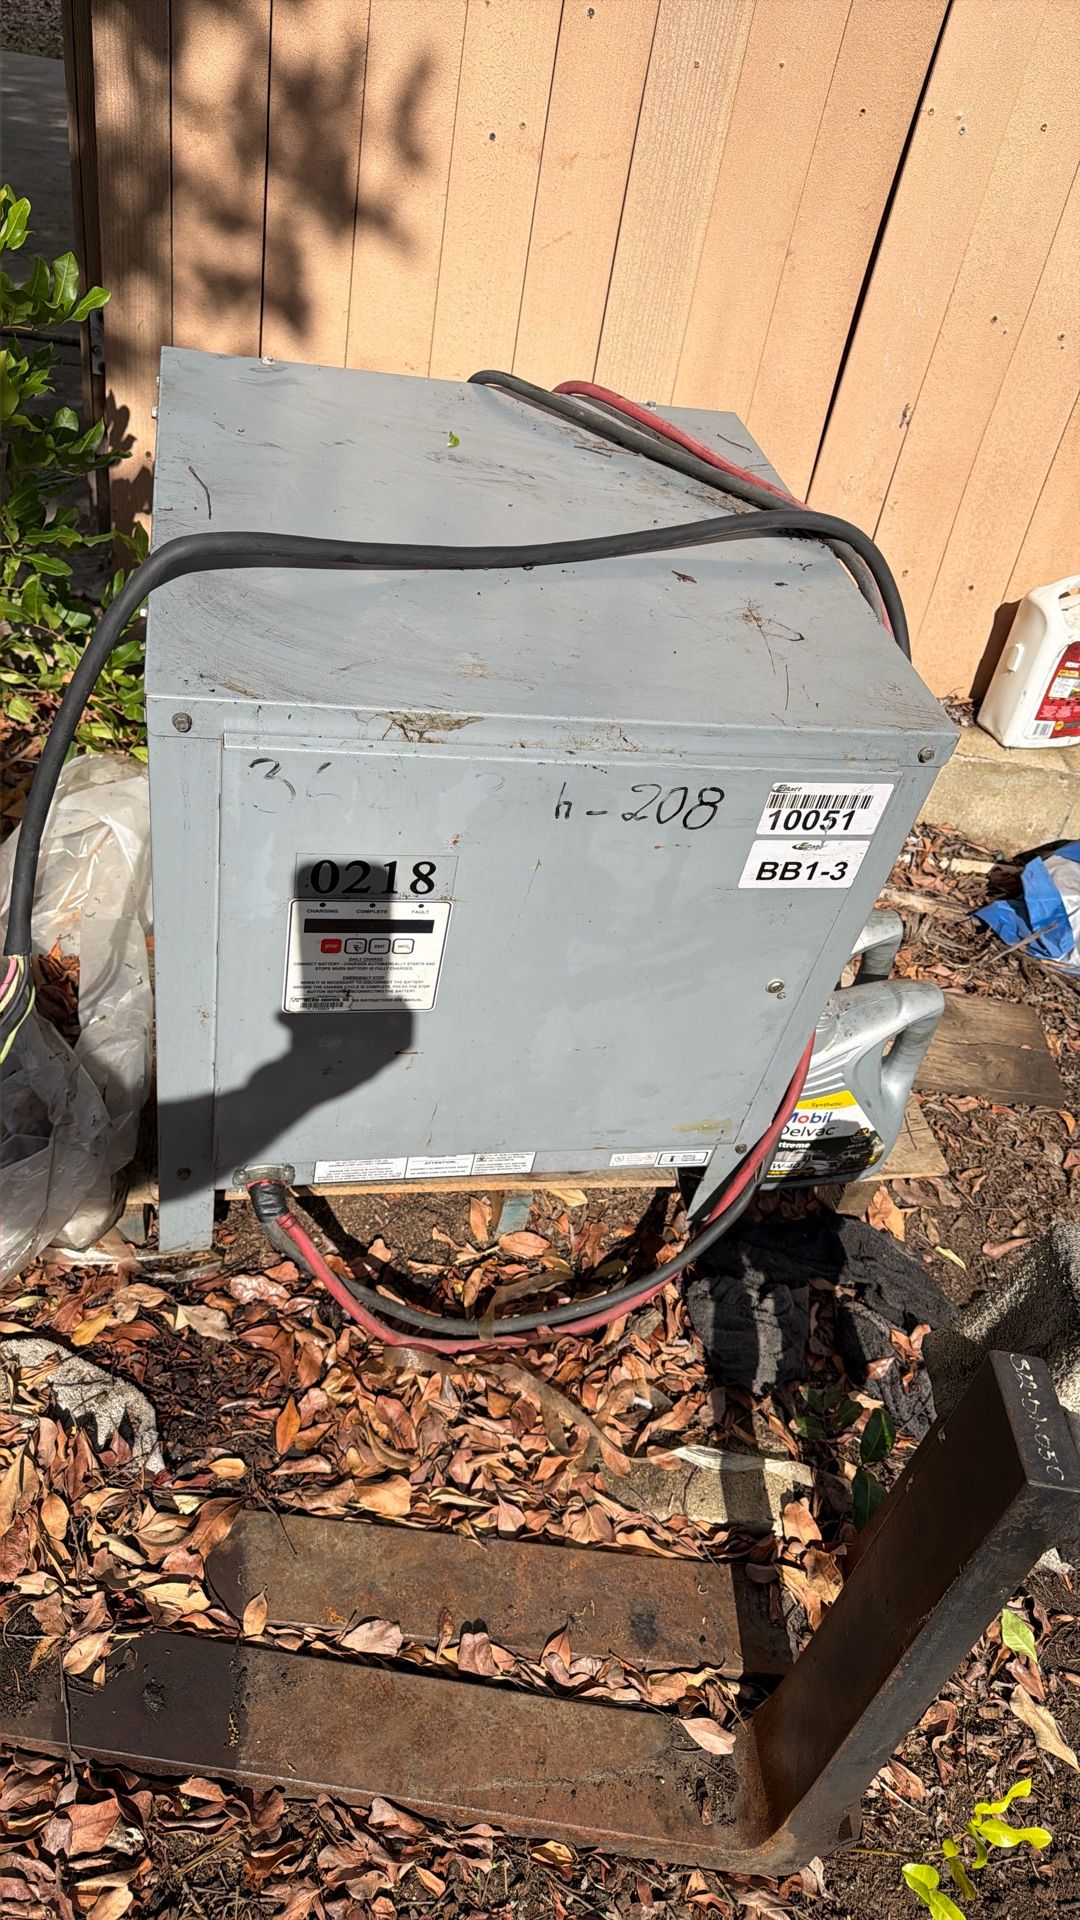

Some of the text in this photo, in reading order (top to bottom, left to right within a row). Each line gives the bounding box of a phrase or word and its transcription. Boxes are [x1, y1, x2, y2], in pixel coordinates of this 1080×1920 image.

[768, 809, 856, 831] 10051
[310, 860, 437, 895] 0218
[755, 861, 849, 881] BB1-3
[788, 1111, 833, 1124] Mobil
[780, 1125, 836, 1137] Delvac
[778, 1141, 811, 1149] treme
